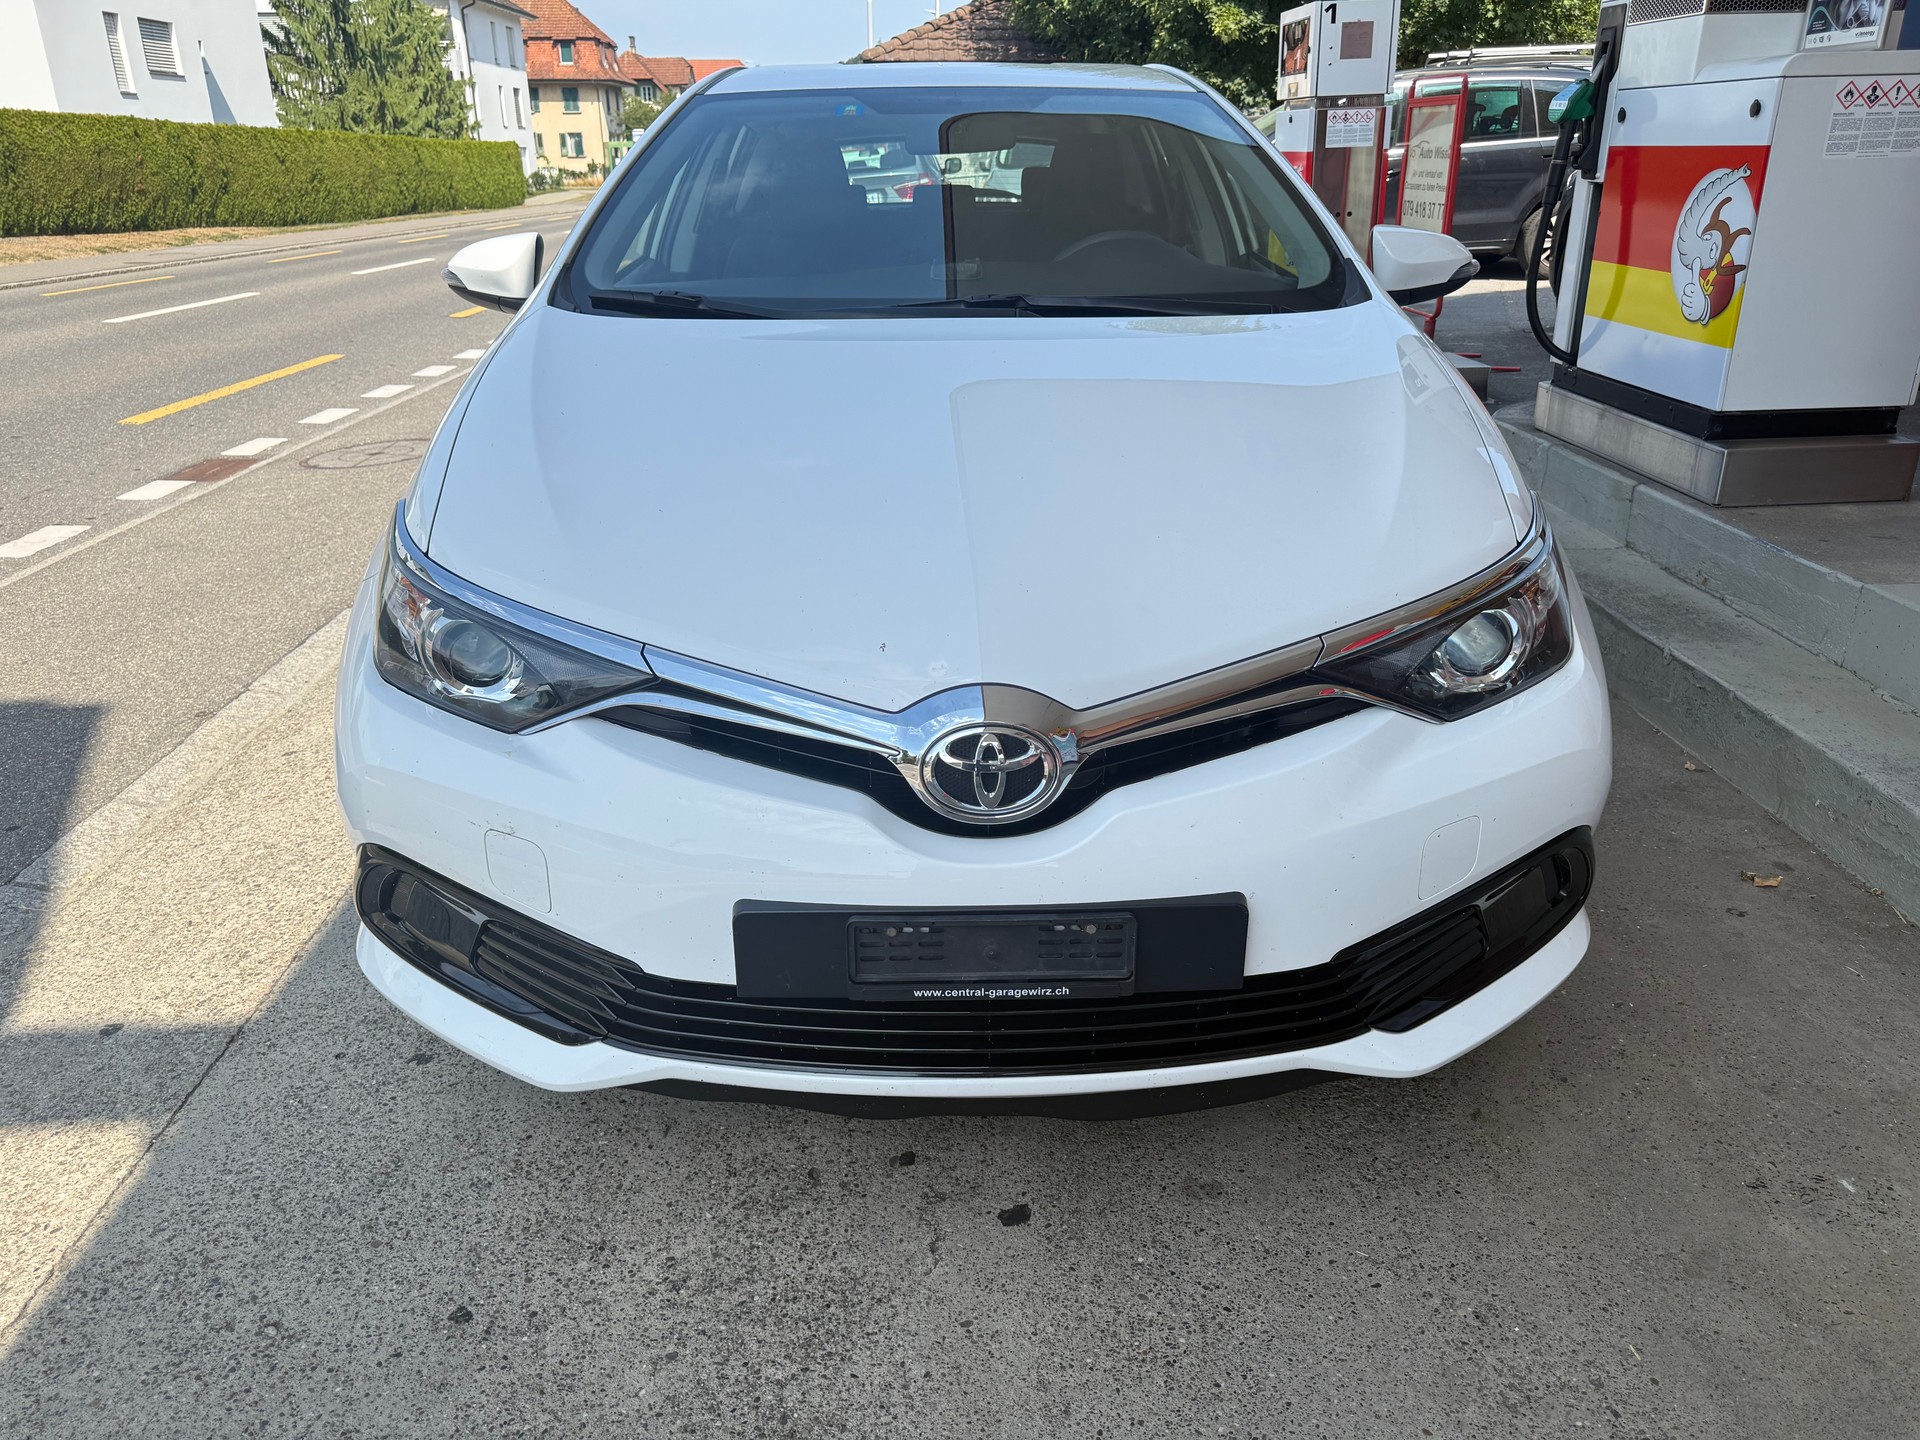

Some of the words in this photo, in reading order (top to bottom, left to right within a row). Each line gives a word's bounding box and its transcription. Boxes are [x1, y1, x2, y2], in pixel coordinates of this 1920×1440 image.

[1324, 3, 1337, 24] 1
[1419, 146, 1433, 159] Auto
[1403, 199, 1414, 217] 079
[1415, 201, 1426, 219] 418
[1427, 202, 1436, 220] 37
[913, 986, 1070, 998] www.central-garagewirz.ch
